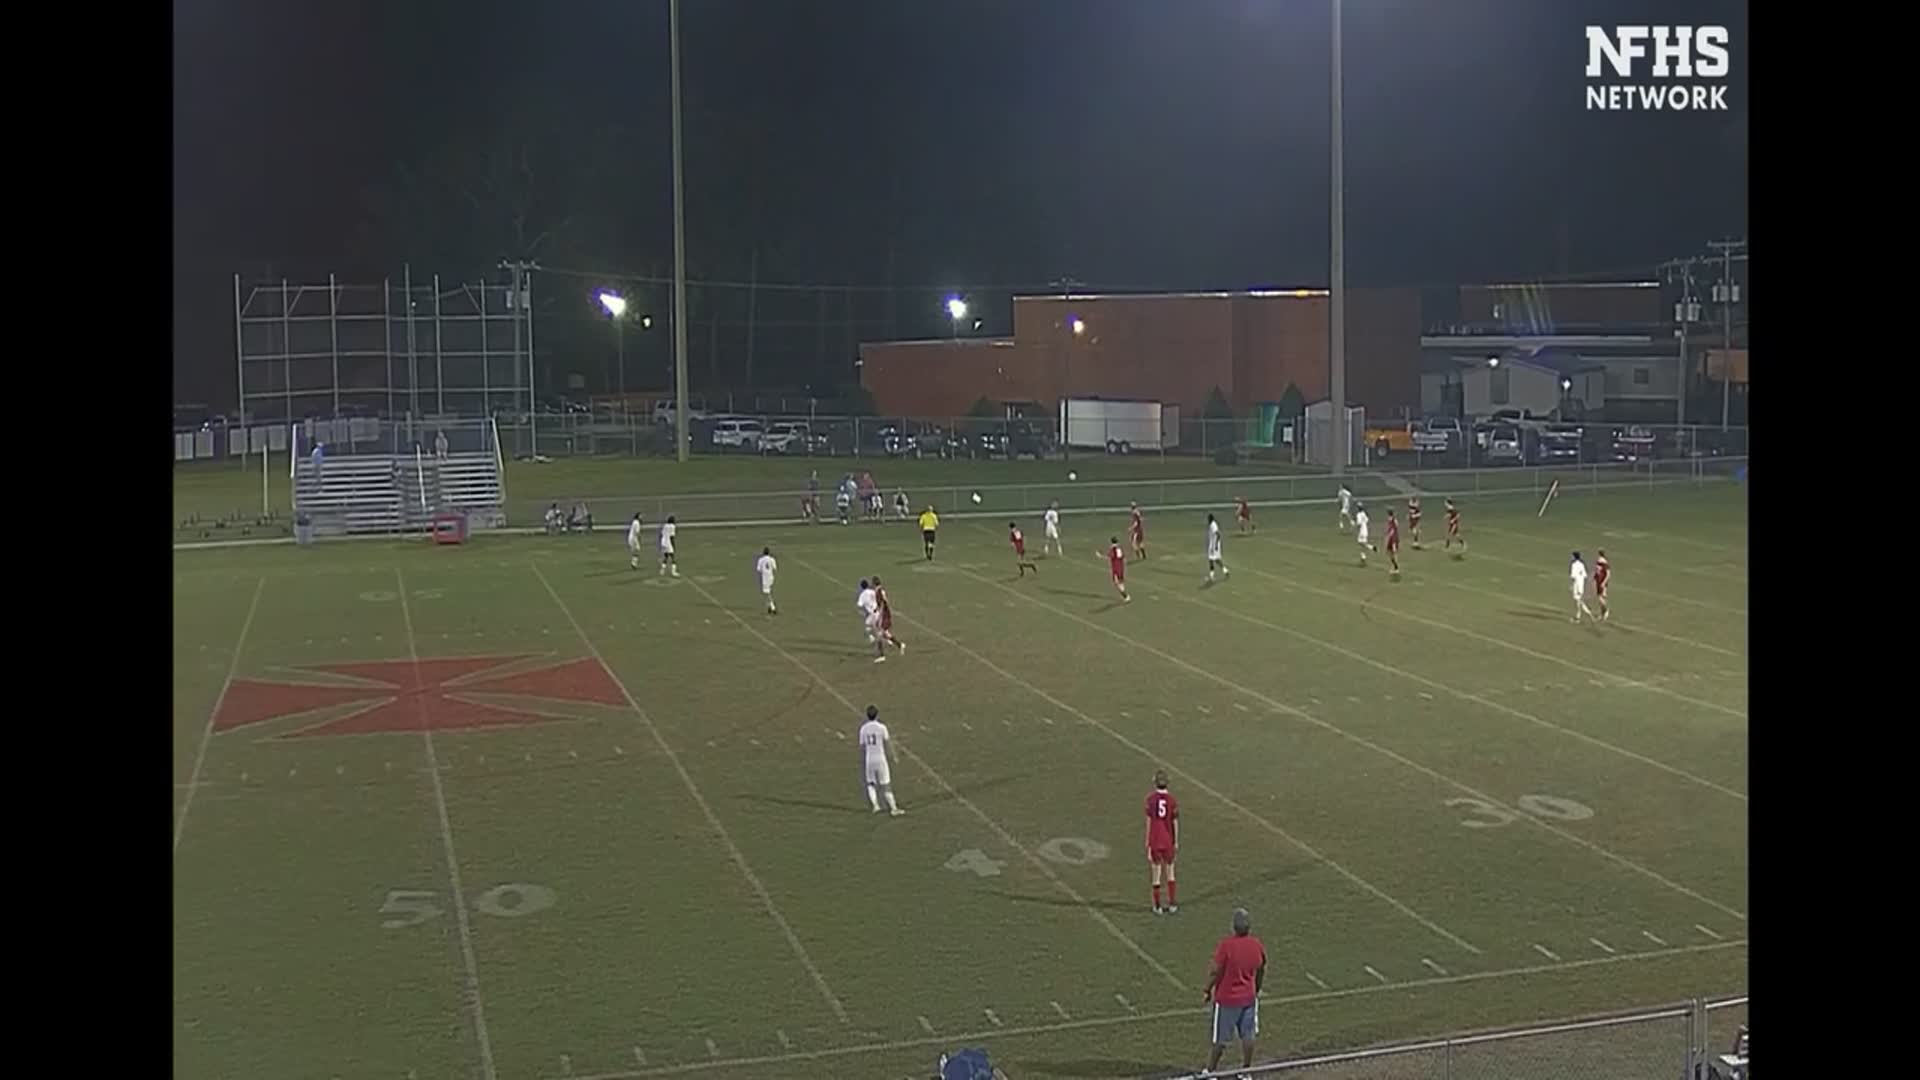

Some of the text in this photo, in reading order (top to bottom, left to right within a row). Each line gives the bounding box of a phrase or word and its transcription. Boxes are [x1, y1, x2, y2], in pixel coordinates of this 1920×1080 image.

[1158, 799, 1167, 817] 5
[1445, 795, 1594, 828] 30
[944, 837, 1111, 877] 40
[379, 883, 557, 928] 50
